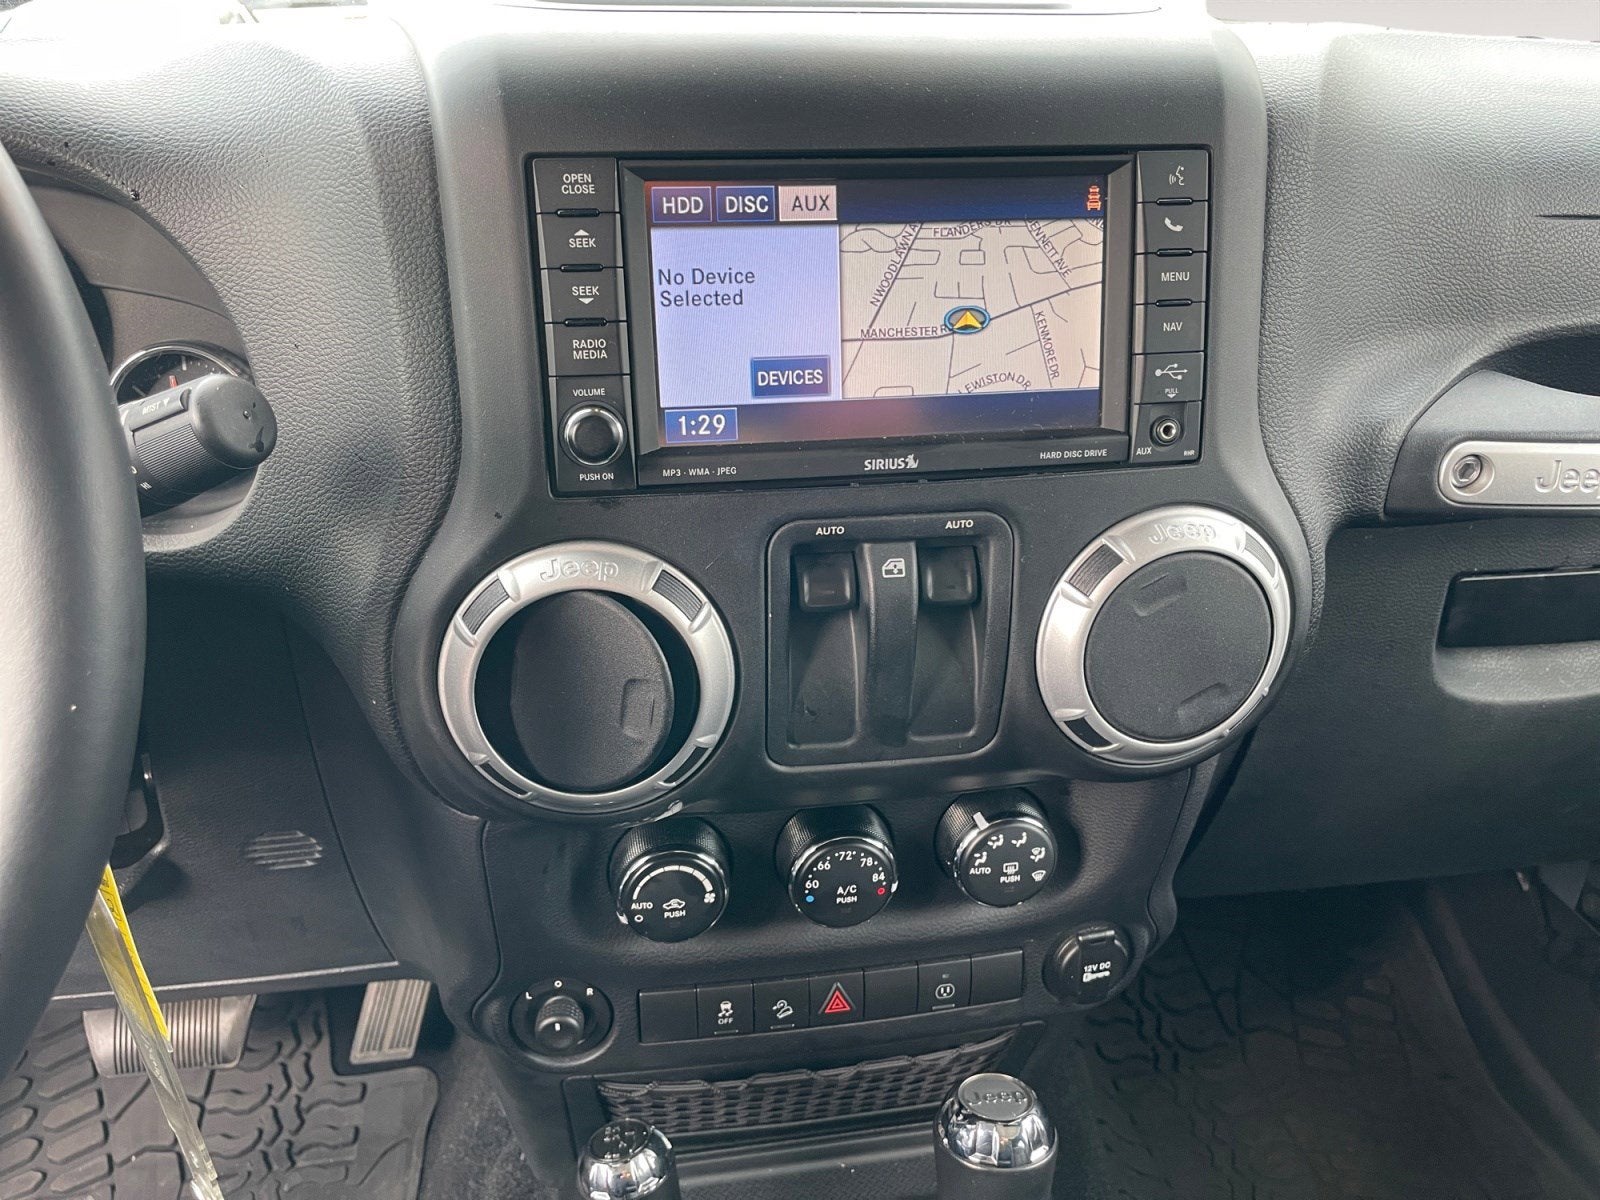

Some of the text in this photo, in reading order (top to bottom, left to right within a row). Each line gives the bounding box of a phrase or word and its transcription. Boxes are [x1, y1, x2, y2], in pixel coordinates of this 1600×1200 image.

[562, 173, 592, 184] OPEN
[561, 184, 596, 195] CLOSE
[662, 196, 704, 215] HDD
[725, 195, 769, 214] DISC
[791, 194, 831, 212] AUX
[568, 237, 597, 248] SEEK
[873, 230, 914, 298] WOODLAWN
[1054, 258, 1072, 278] AVE
[658, 268, 756, 286] No Device
[1161, 271, 1190, 283] MENU
[571, 285, 600, 297] SEEK
[660, 289, 743, 307] Selected
[870, 296, 881, 307] N
[860, 326, 938, 338] MANCHESTER
[1163, 322, 1183, 332] NAV
[573, 338, 607, 350] RADIO
[573, 349, 608, 360] MEDIA
[757, 369, 824, 387] DEVICES
[1015, 375, 1031, 391] DR
[572, 387, 606, 397] VOLUME
[677, 414, 726, 436] 1:29
[1040, 448, 1108, 460] HARD DISC DRIVE
[1136, 446, 1152, 456] AUX
[864, 458, 904, 471] SIRIUS
[579, 472, 614, 481] PUSH ON
[662, 466, 737, 477] MP3 WMA JPEG
[1534, 459, 1600, 499] Jee
[945, 519, 974, 530] AUTO
[815, 526, 845, 536] AUTO
[1148, 523, 1216, 545] Jeep
[539, 558, 619, 582] Jeep
[839, 850, 853, 861] 72
[817, 860, 831, 870] 66
[860, 857, 873, 867] 78
[969, 866, 990, 874] AUTO
[872, 871, 885, 882] 84
[1000, 874, 1021, 883] PUSH
[805, 880, 819, 889] 60
[837, 884, 857, 895] A/C
[836, 895, 858, 904] PUSH
[631, 902, 653, 910] AUTO
[664, 909, 686, 919] PUSH
[1083, 963, 1099, 973] 12V
[525, 991, 532, 1000] L
[586, 987, 594, 996] R
[717, 1017, 734, 1025] OFF
[968, 1090, 1028, 1106] Jeep
